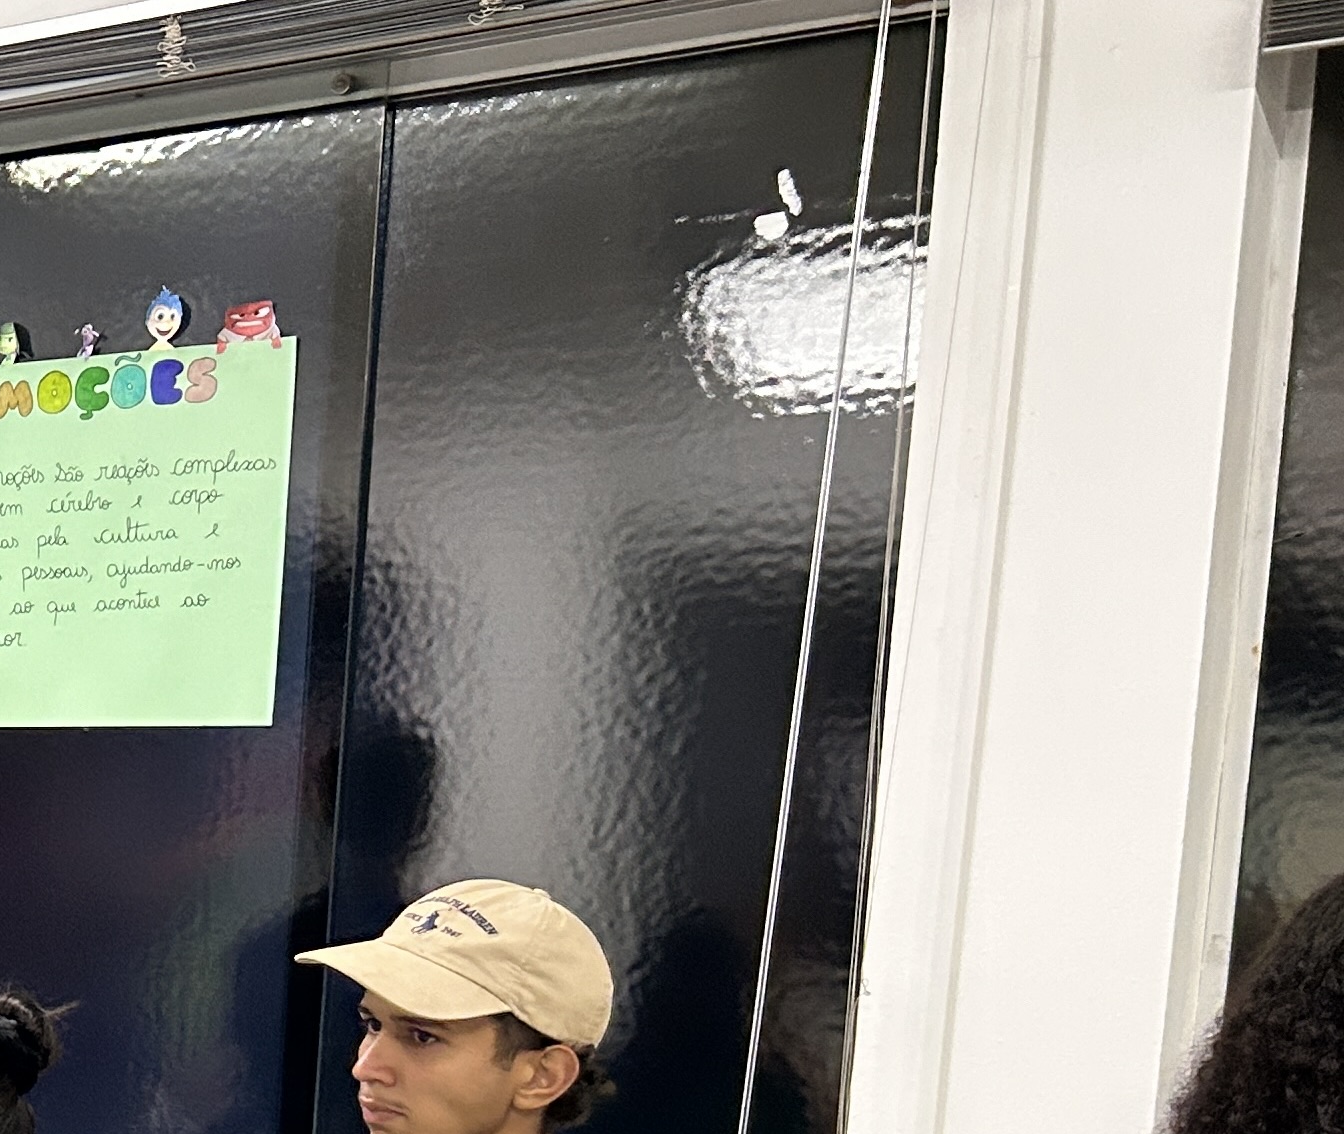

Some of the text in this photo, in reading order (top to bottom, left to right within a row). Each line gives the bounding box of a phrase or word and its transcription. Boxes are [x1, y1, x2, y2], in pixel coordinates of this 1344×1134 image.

[94, 457, 161, 486] reações
[169, 449, 278, 486] complexas
[45, 489, 113, 514] cérebro
[130, 494, 143, 509] e
[168, 488, 225, 515] corpo
[36, 524, 70, 560] pela
[93, 516, 179, 545] cultura
[204, 522, 221, 540] e
[21, 565, 94, 594] pessoais,
[106, 554, 242, 589] ajudando-nos
[8, 599, 36, 617] ao
[46, 599, 77, 627] que
[92, 589, 162, 613] acontece
[179, 593, 212, 609] ao
